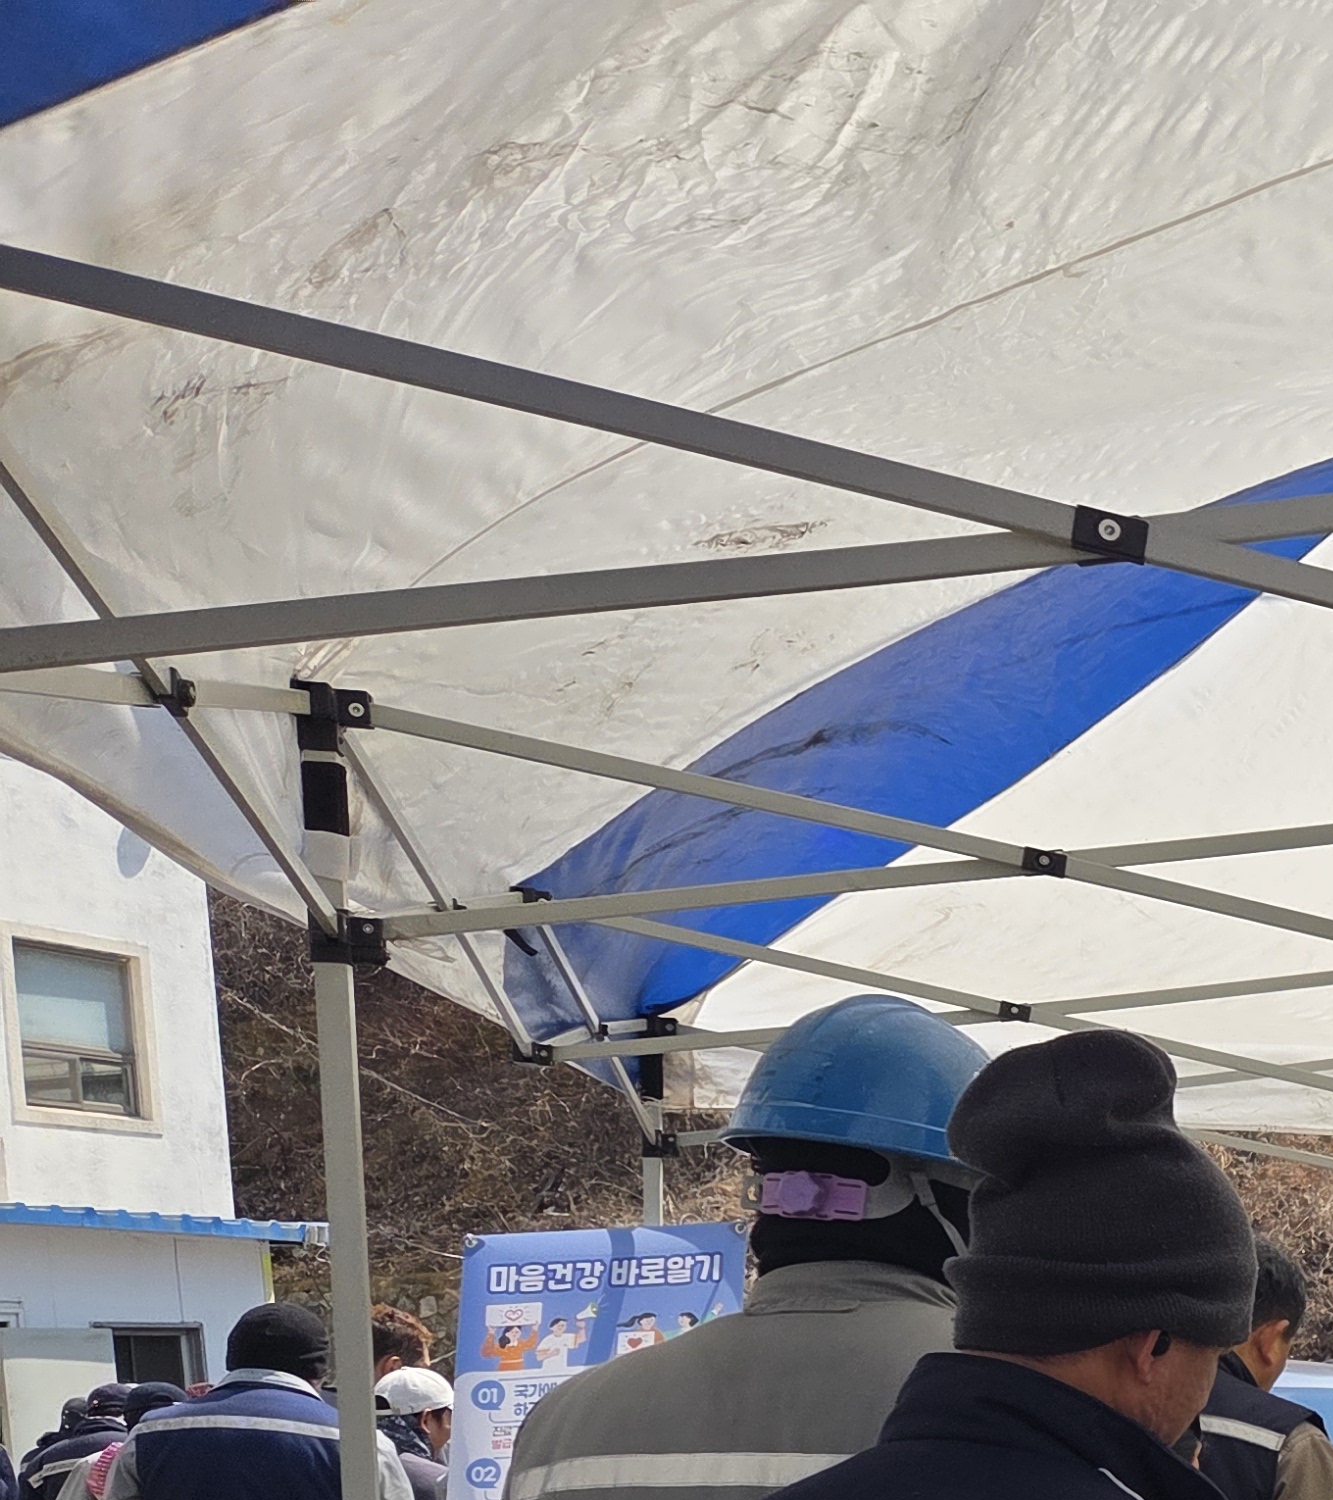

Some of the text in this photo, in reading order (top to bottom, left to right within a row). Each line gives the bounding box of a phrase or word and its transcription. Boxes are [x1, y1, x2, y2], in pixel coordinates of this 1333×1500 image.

[489, 1254, 721, 1292] 마음건강 바로알기
[478, 1387, 499, 1404] 01
[471, 1466, 497, 1482] 02
